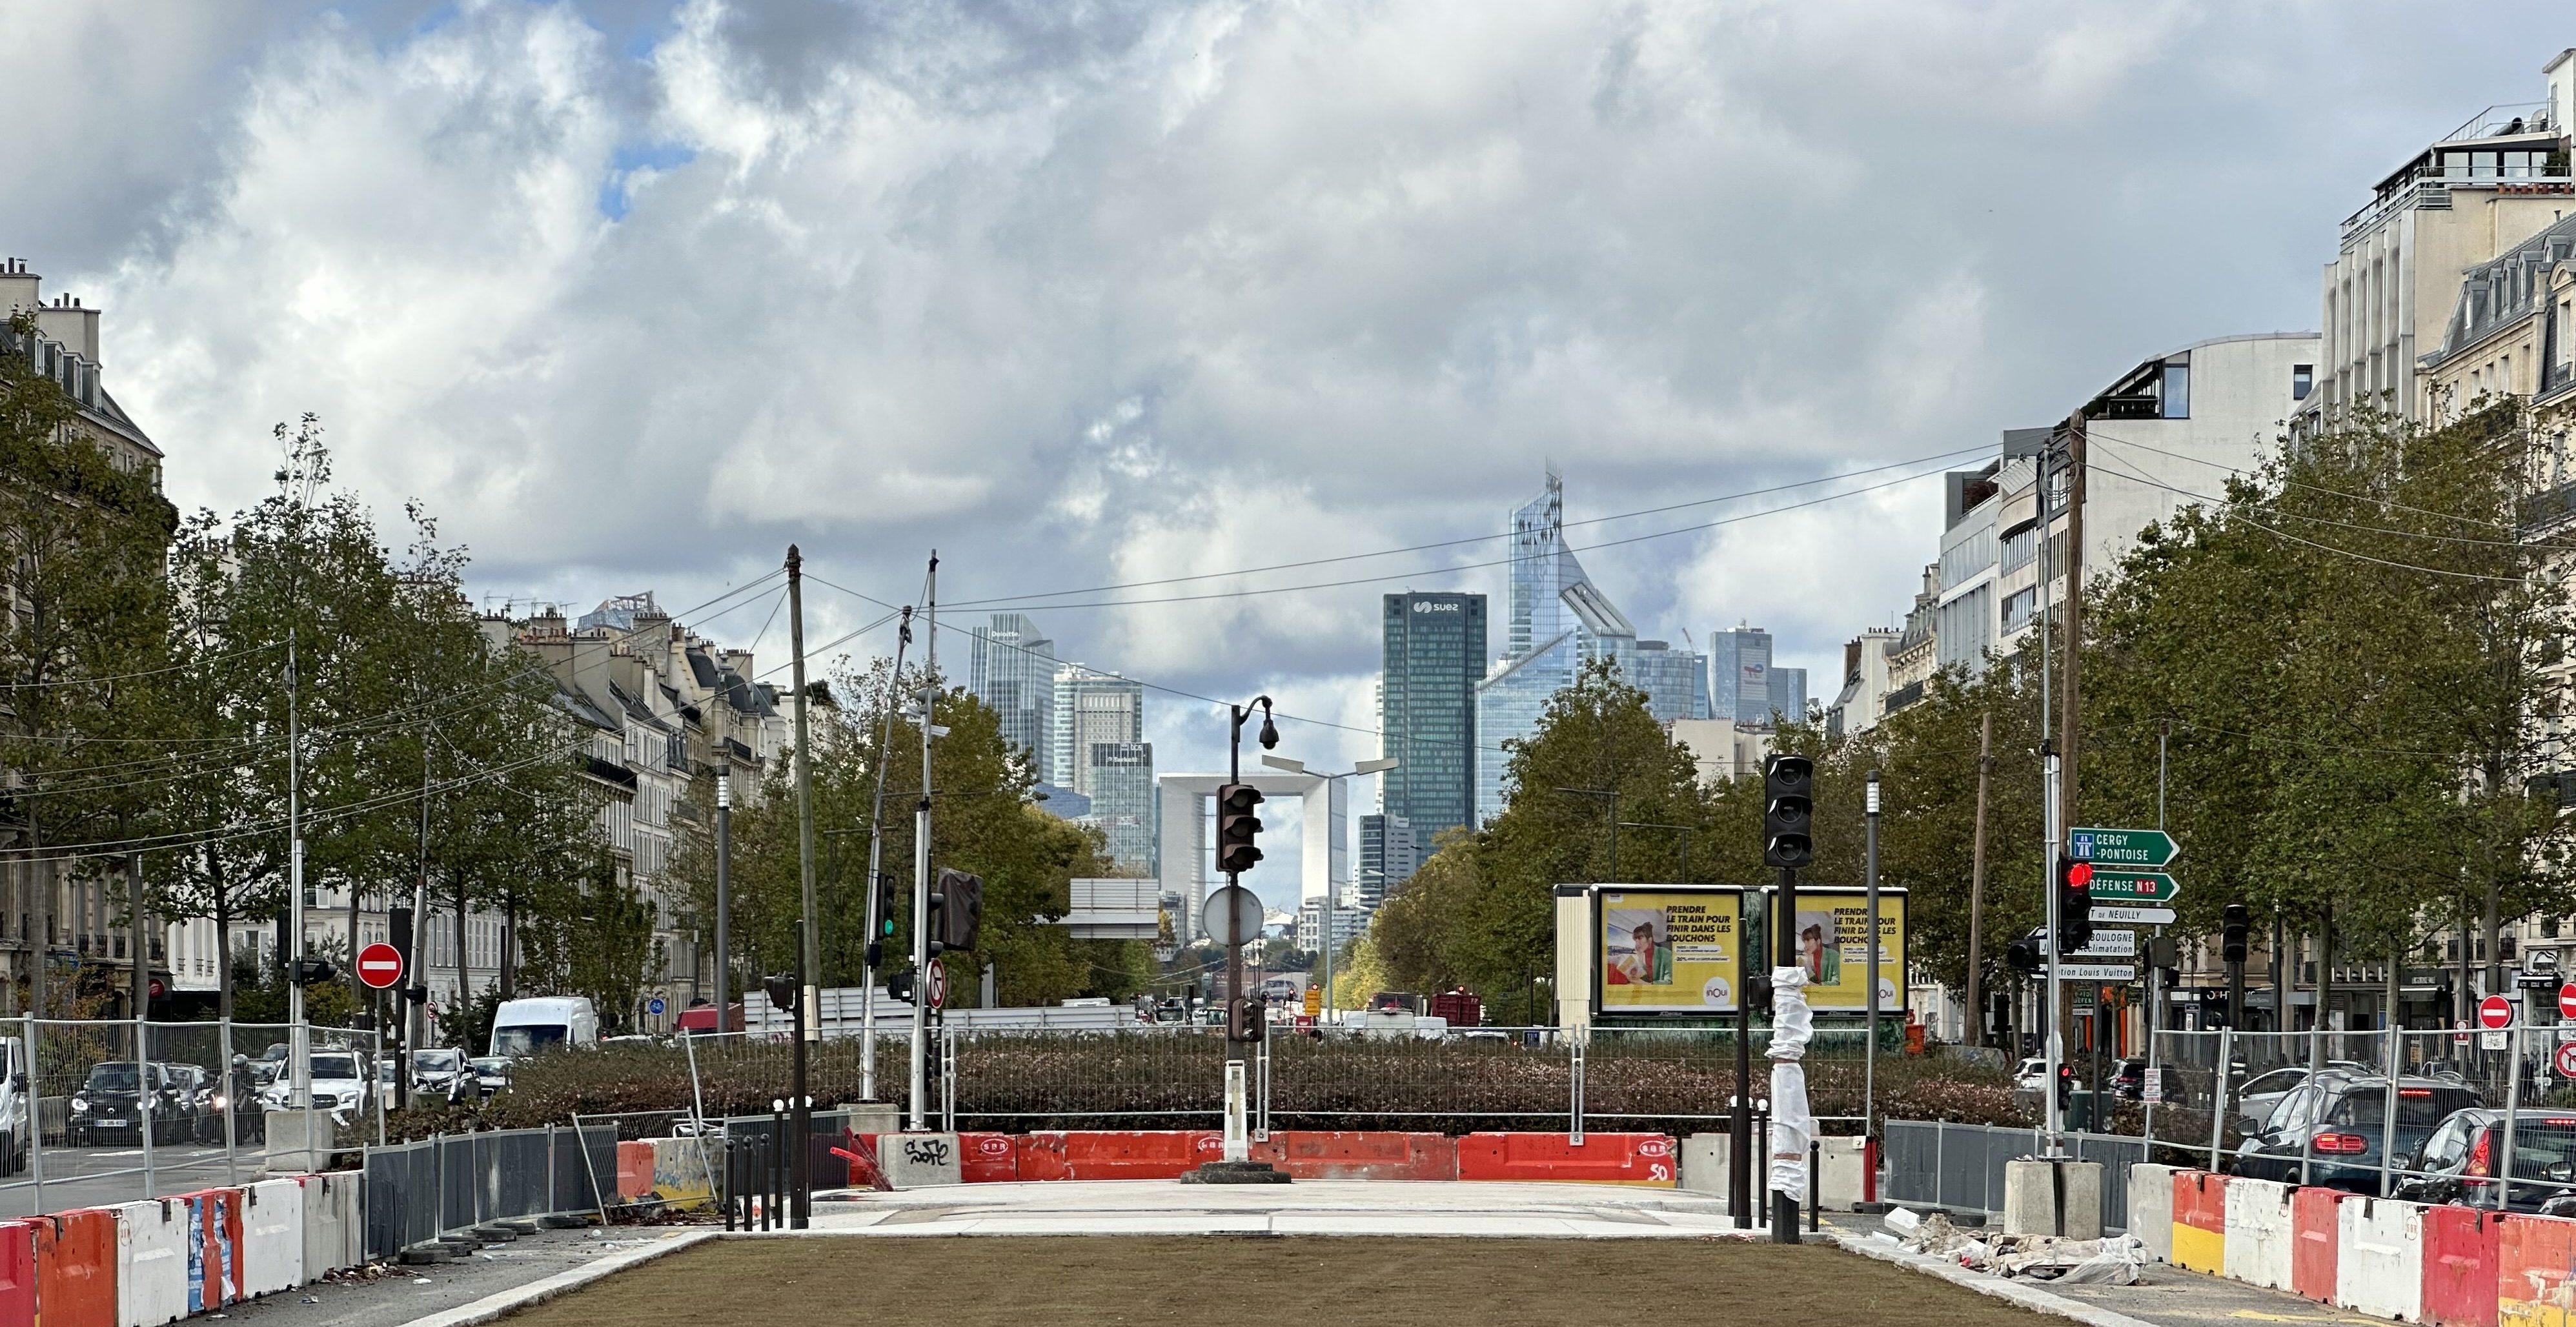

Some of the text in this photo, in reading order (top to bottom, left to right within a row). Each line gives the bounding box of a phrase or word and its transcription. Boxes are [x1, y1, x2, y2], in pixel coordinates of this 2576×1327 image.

[2096, 834, 2128, 845] CERGY
[2096, 849, 2149, 860] -PONTOISE
[2089, 876, 2156, 893] DÉFENSE N 13
[1666, 906, 1706, 914] PRENDRE
[1834, 907, 1868, 916] PRENDR
[1706, 915, 1730, 924] POUR
[2108, 910, 2142, 920] NEUILLY
[1666, 924, 1731, 933] FINIR DANS LES
[1834, 926, 1856, 935] FINIR
[1666, 934, 1716, 942] BOUCHONS
[1834, 936, 1881, 944] BOUCHOS
[2090, 933, 2133, 942] BOULOGNE
[2079, 967, 2100, 977] Louis
[2104, 967, 2133, 977] Vuitton
